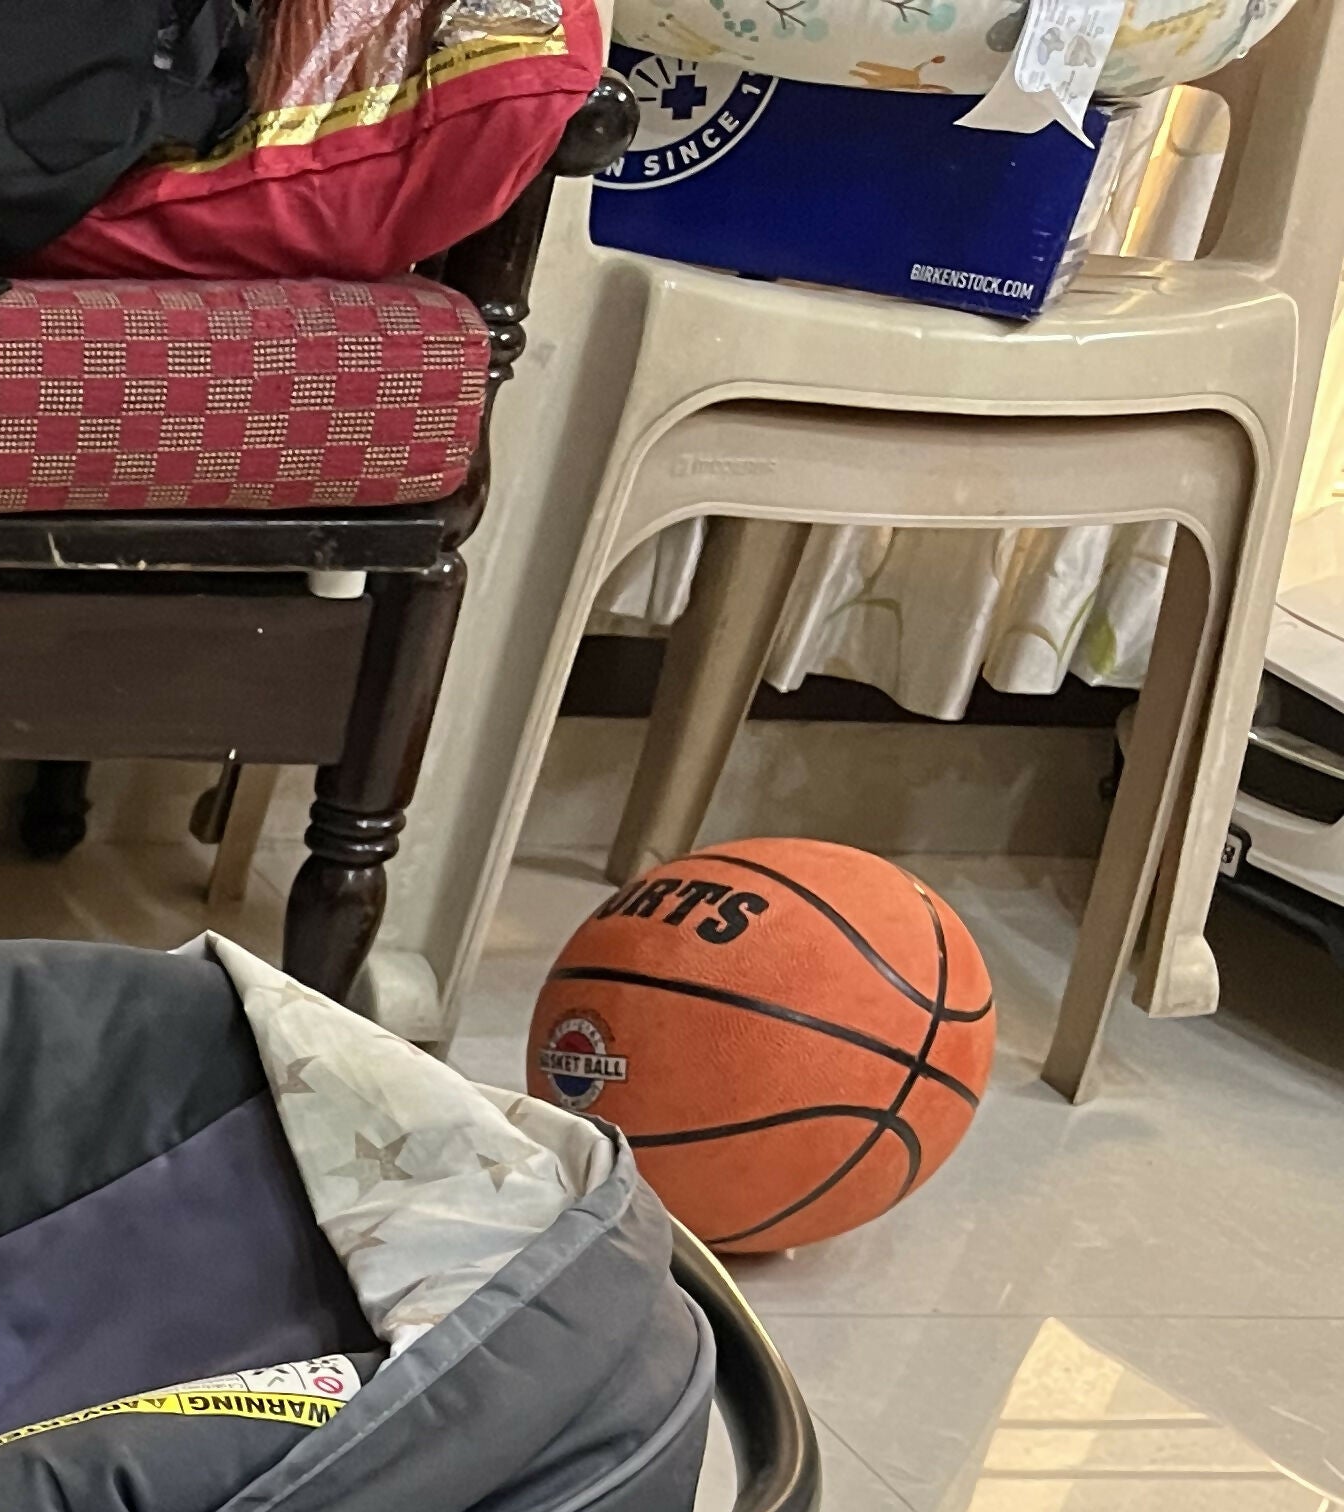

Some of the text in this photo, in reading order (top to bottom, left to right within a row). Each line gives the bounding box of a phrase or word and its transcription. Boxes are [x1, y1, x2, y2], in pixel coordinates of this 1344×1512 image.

[644, 111, 739, 176] SINCE
[910, 263, 1034, 300] BIRKENSTOCK.COM
[584, 1055, 624, 1077] BALL
[187, 1394, 330, 1427] WARNING
